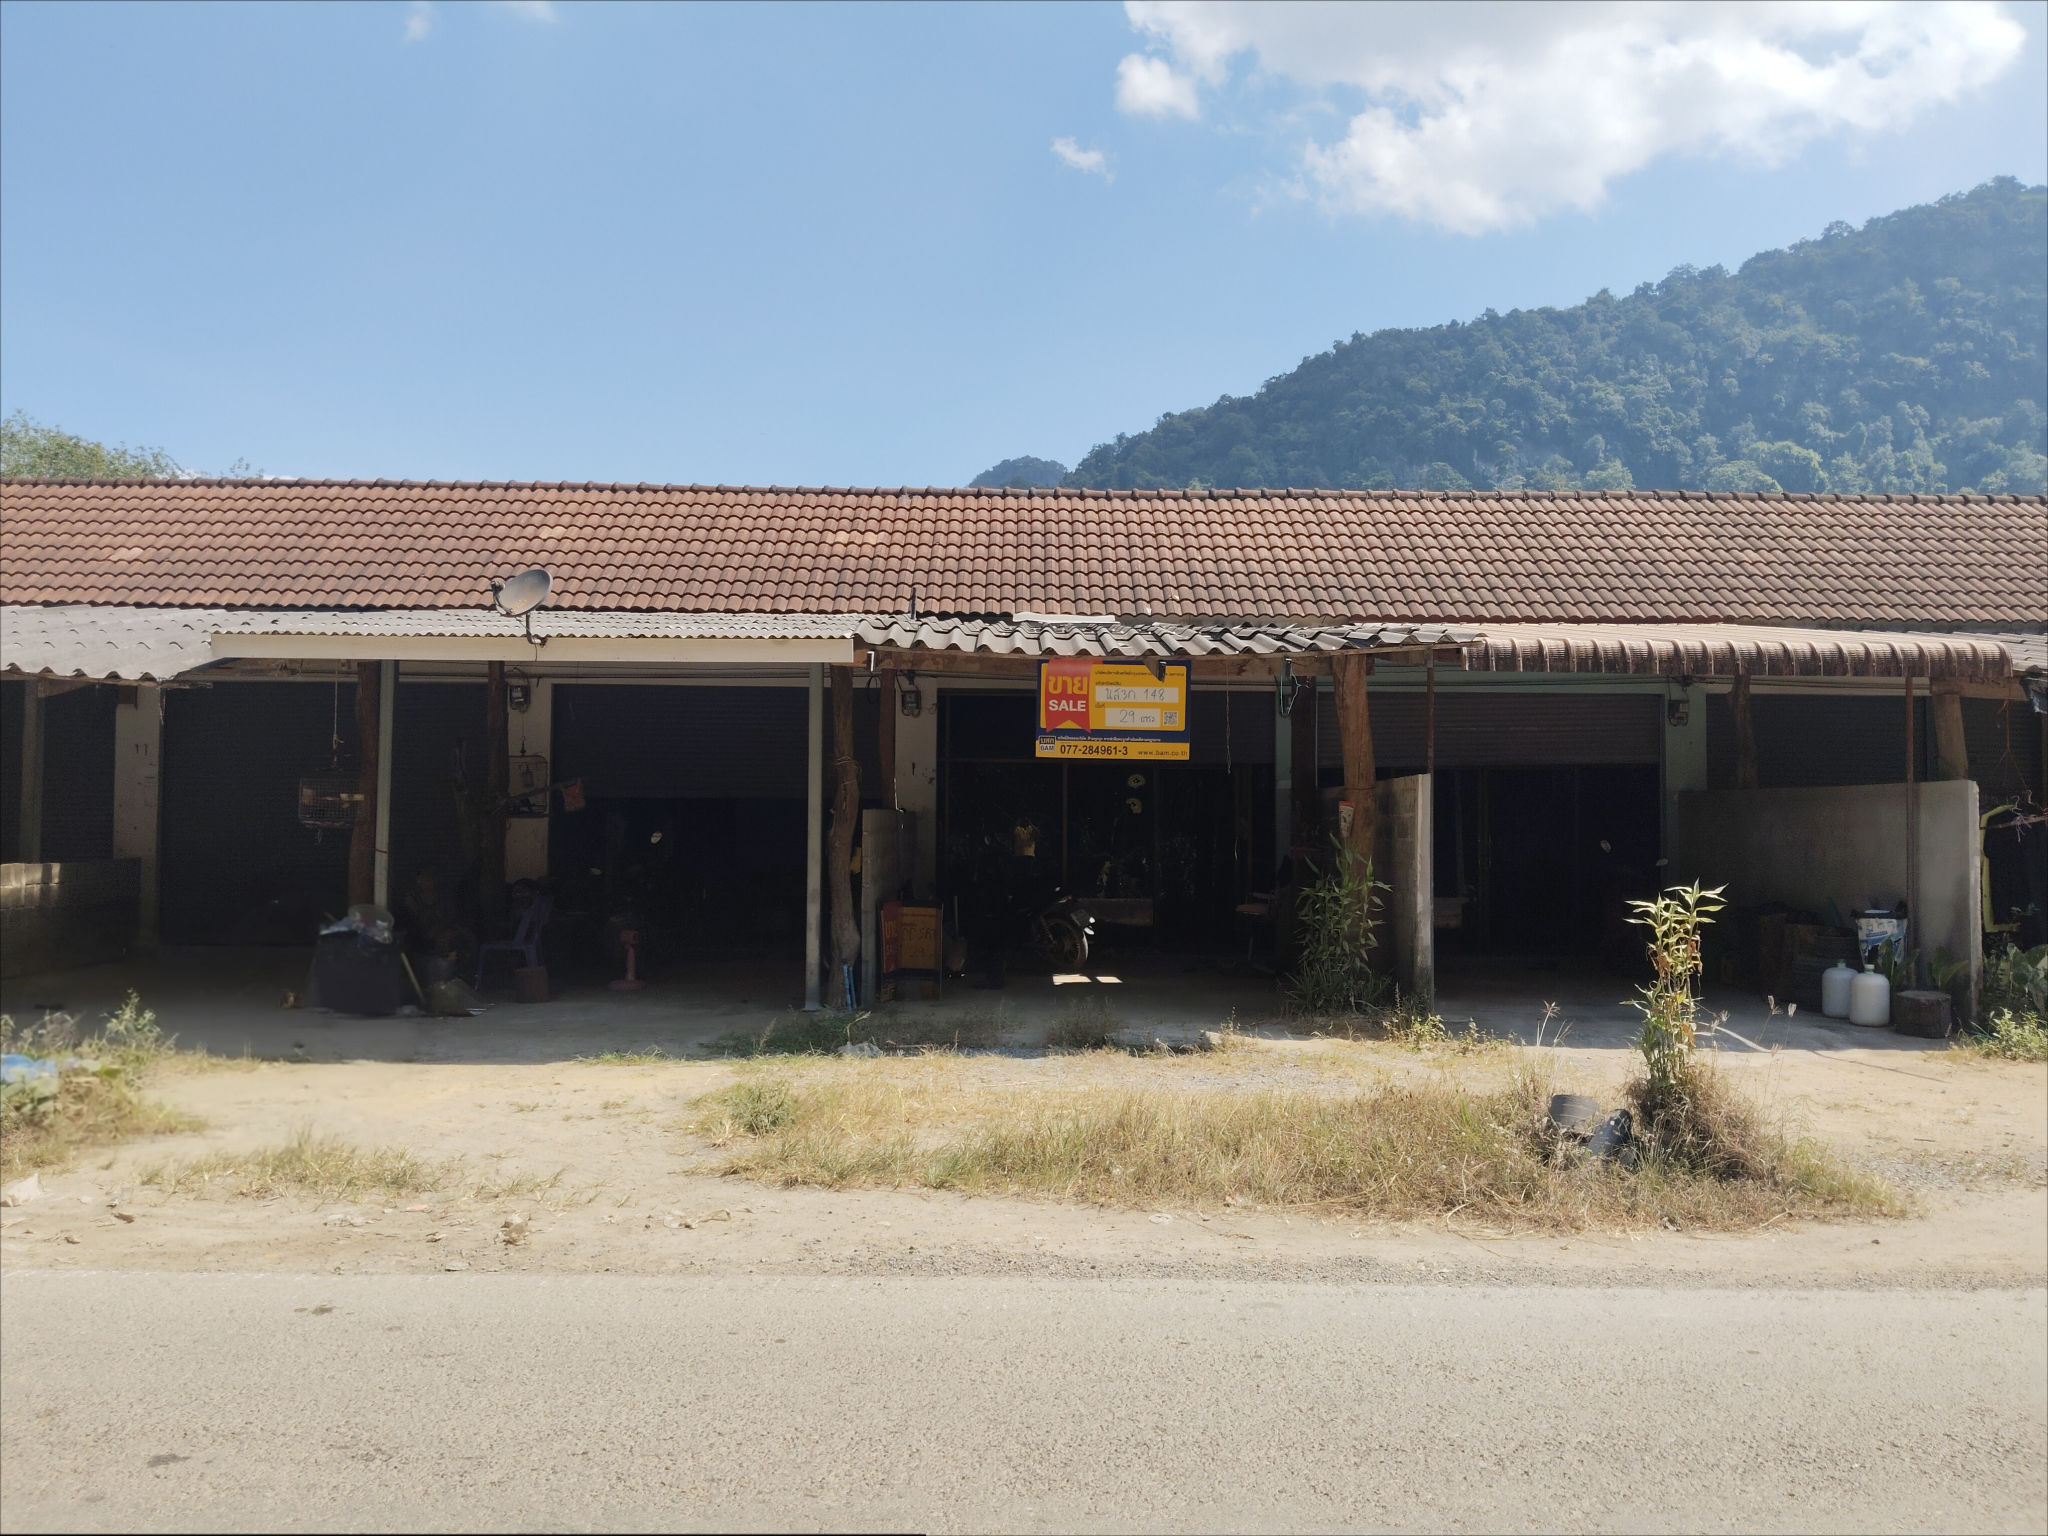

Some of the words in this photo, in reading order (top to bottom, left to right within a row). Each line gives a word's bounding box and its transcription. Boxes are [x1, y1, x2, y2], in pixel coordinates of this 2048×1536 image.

[1048, 675, 1088, 695] ขาย
[1143, 687, 1166, 702] 148
[1048, 699, 1087, 713] SALE
[1119, 709, 1135, 724] 29
[1060, 744, 1128, 756] 077-284961-3
